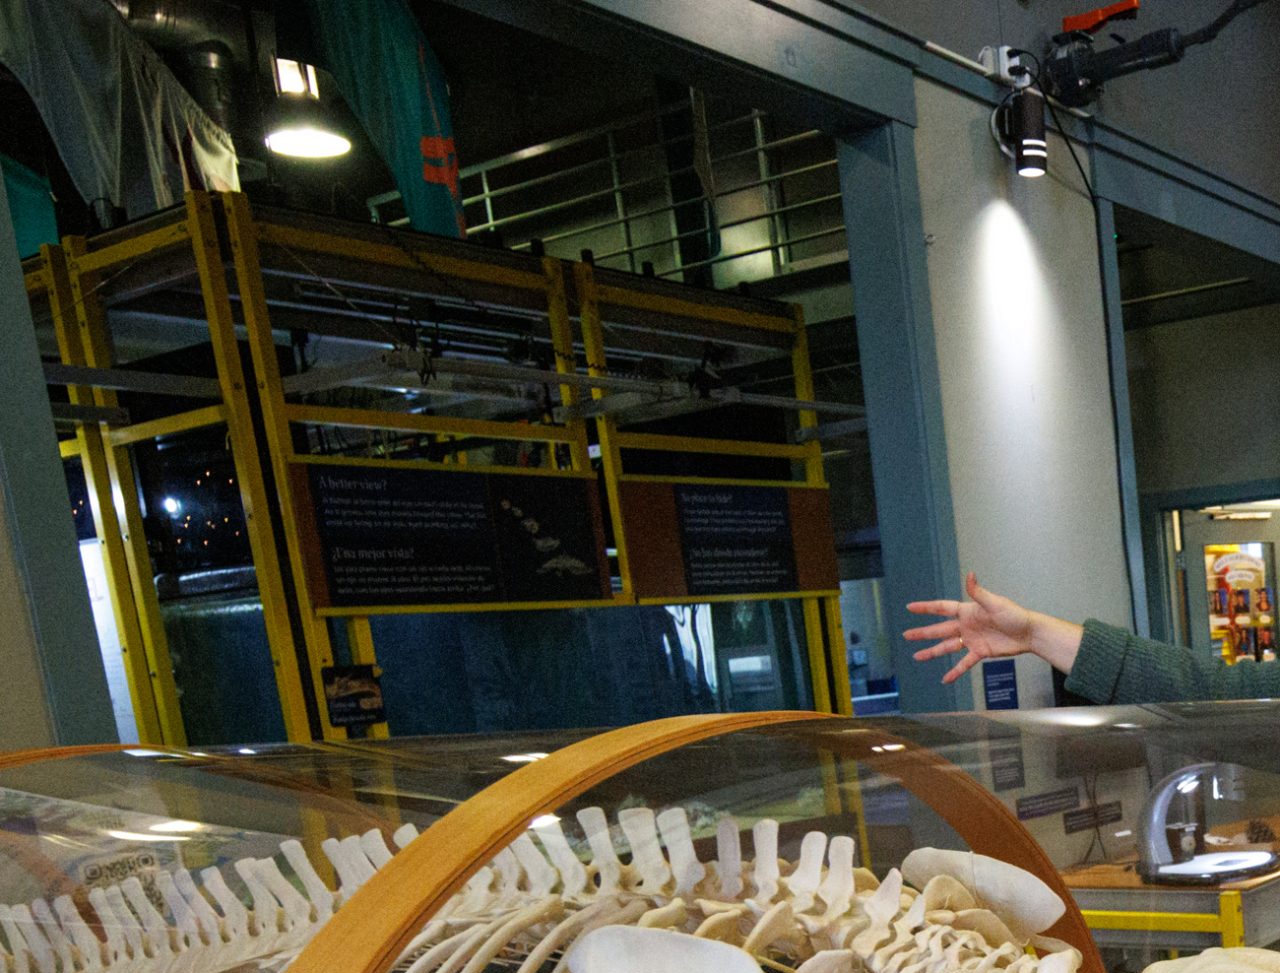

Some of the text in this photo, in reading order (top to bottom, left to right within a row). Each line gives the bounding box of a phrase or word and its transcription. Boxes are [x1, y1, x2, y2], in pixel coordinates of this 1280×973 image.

[319, 475, 387, 491] A better view?
[332, 546, 415, 563] ¿Una mejor vista?
